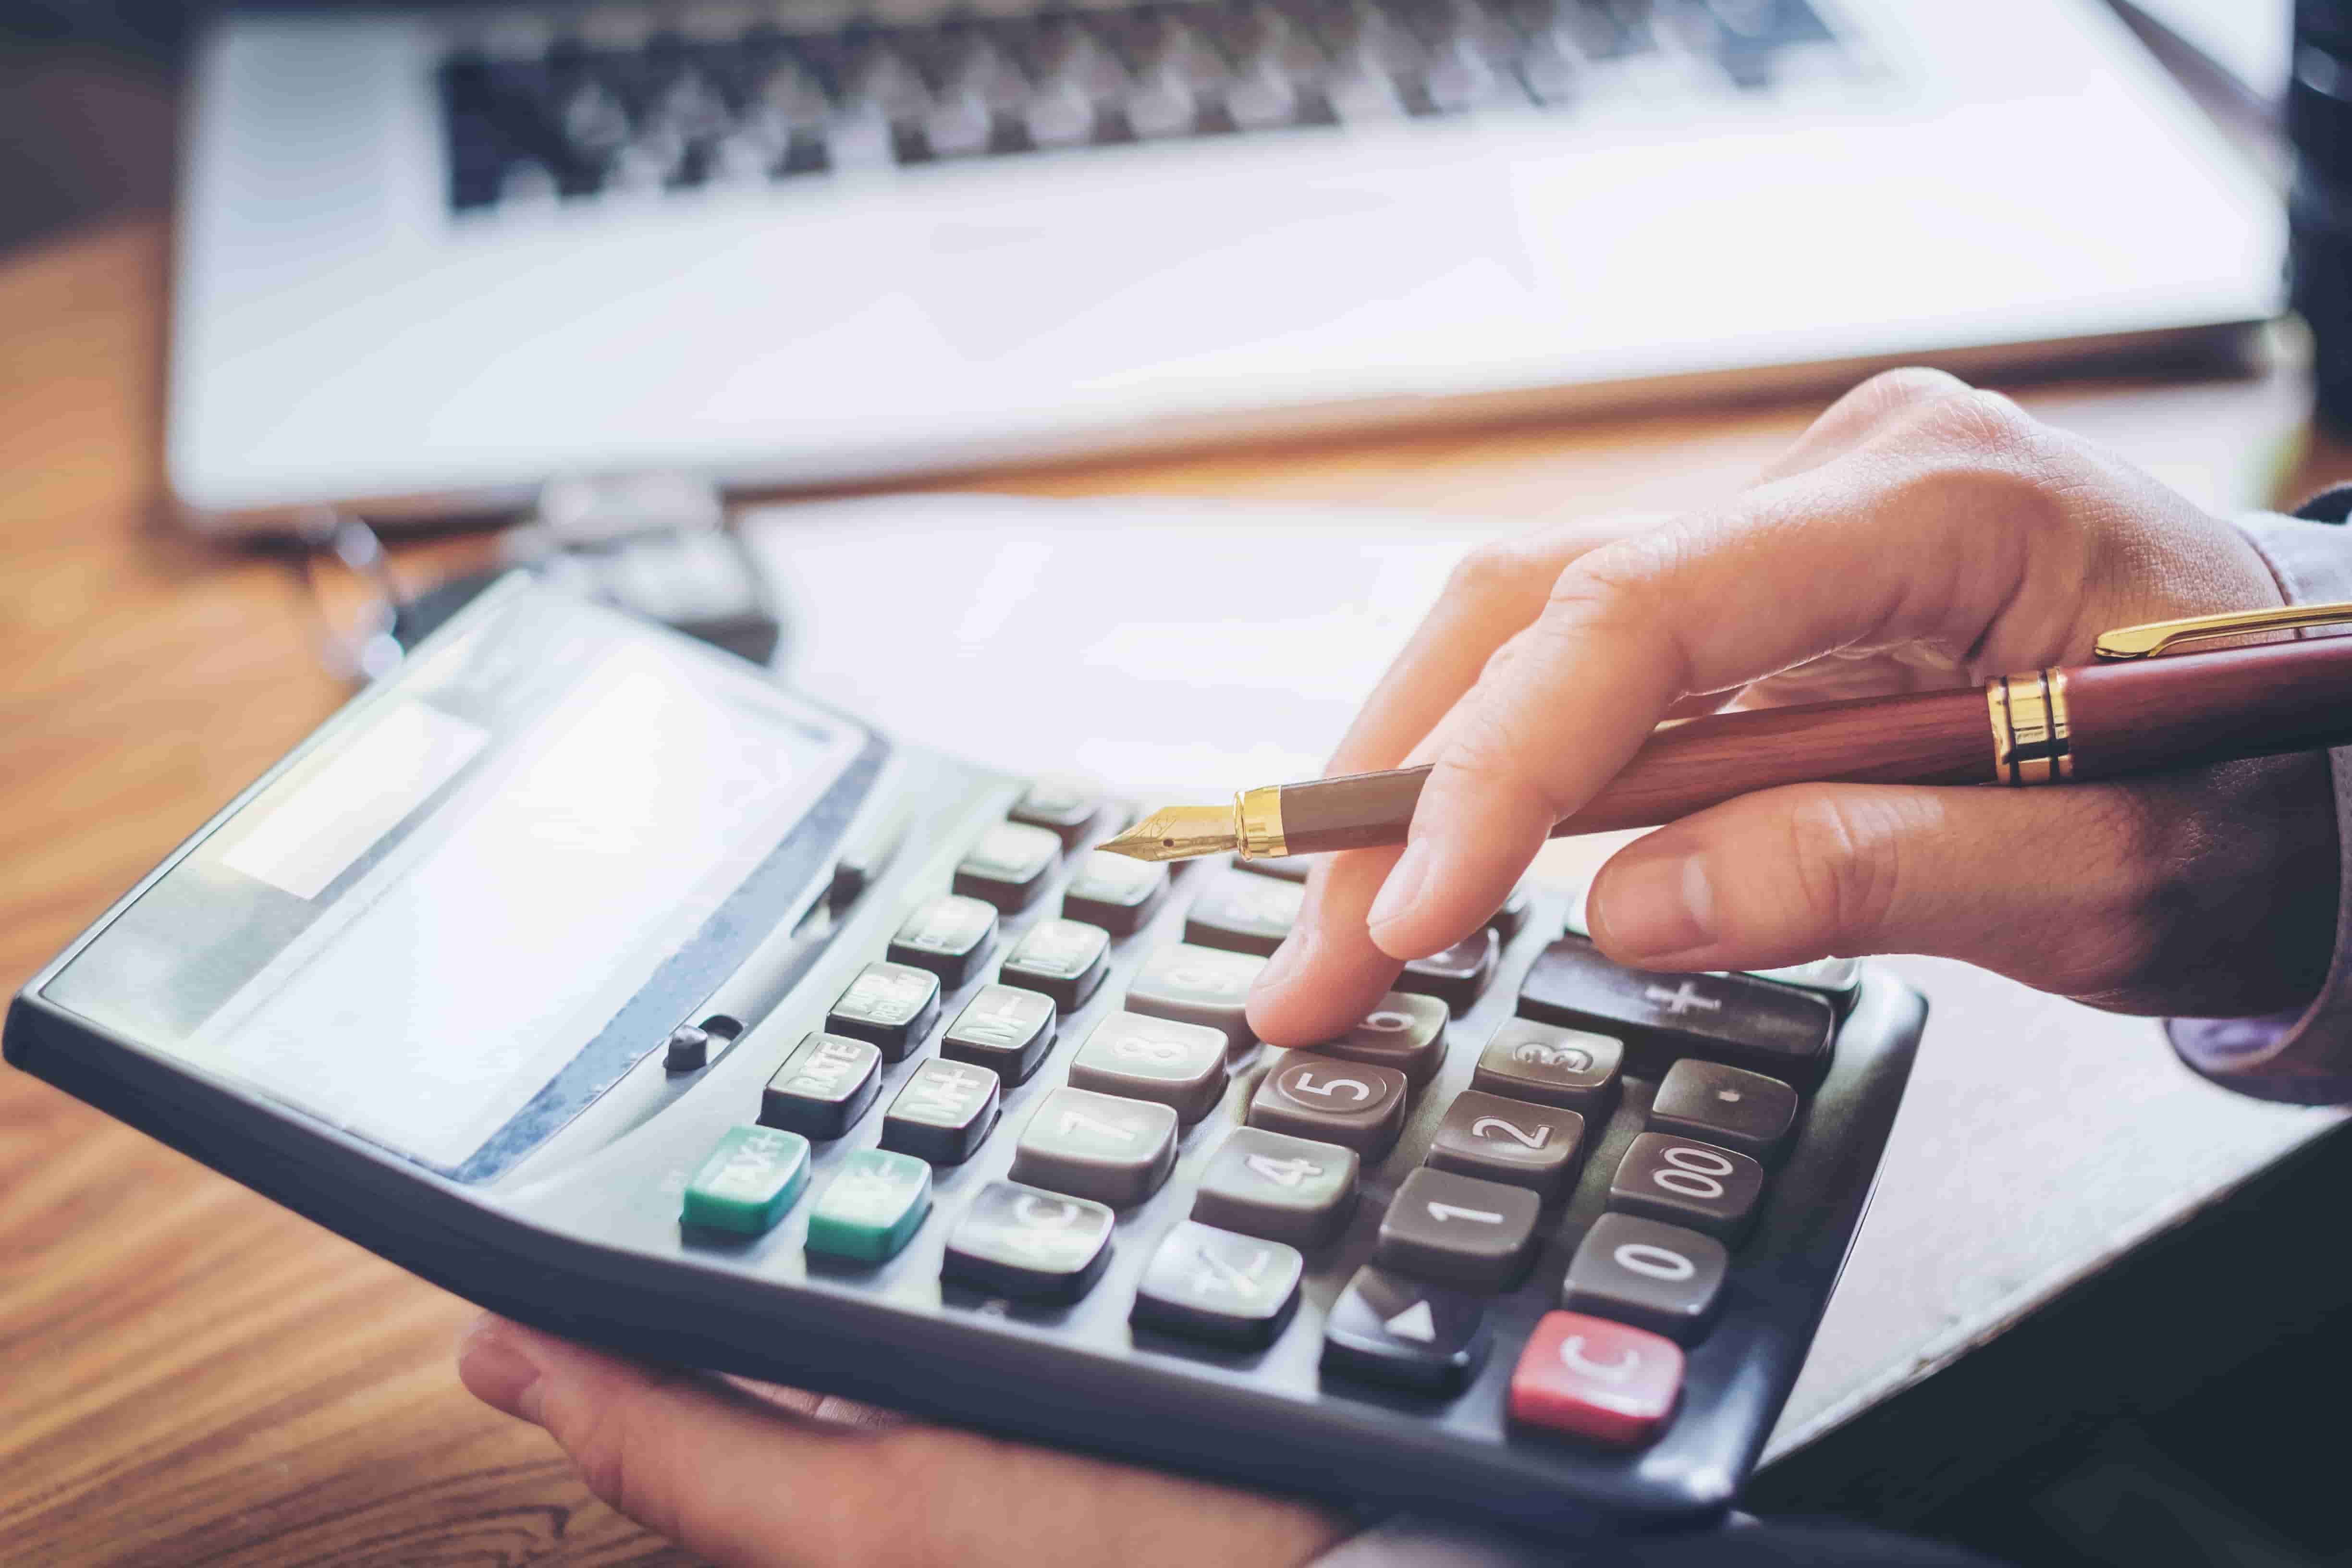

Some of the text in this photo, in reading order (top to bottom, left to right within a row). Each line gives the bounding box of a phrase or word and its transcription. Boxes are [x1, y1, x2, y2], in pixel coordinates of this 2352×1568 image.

[957, 996, 1028, 1042] M-
[787, 1041, 861, 1093] RATE
[1113, 1033, 1190, 1066] 8
[1513, 1042, 1594, 1074] 3
[905, 1068, 981, 1119] M+
[1294, 1072, 1371, 1101] 5
[1060, 1111, 1136, 1141] 7
[1471, 1116, 1552, 1150] 2
[1246, 1153, 1324, 1188] 4
[1653, 1147, 1734, 1199] 00
[1427, 1200, 1505, 1225] 1
[1613, 1243, 1696, 1281] 0
[1560, 1335, 1641, 1384] C
